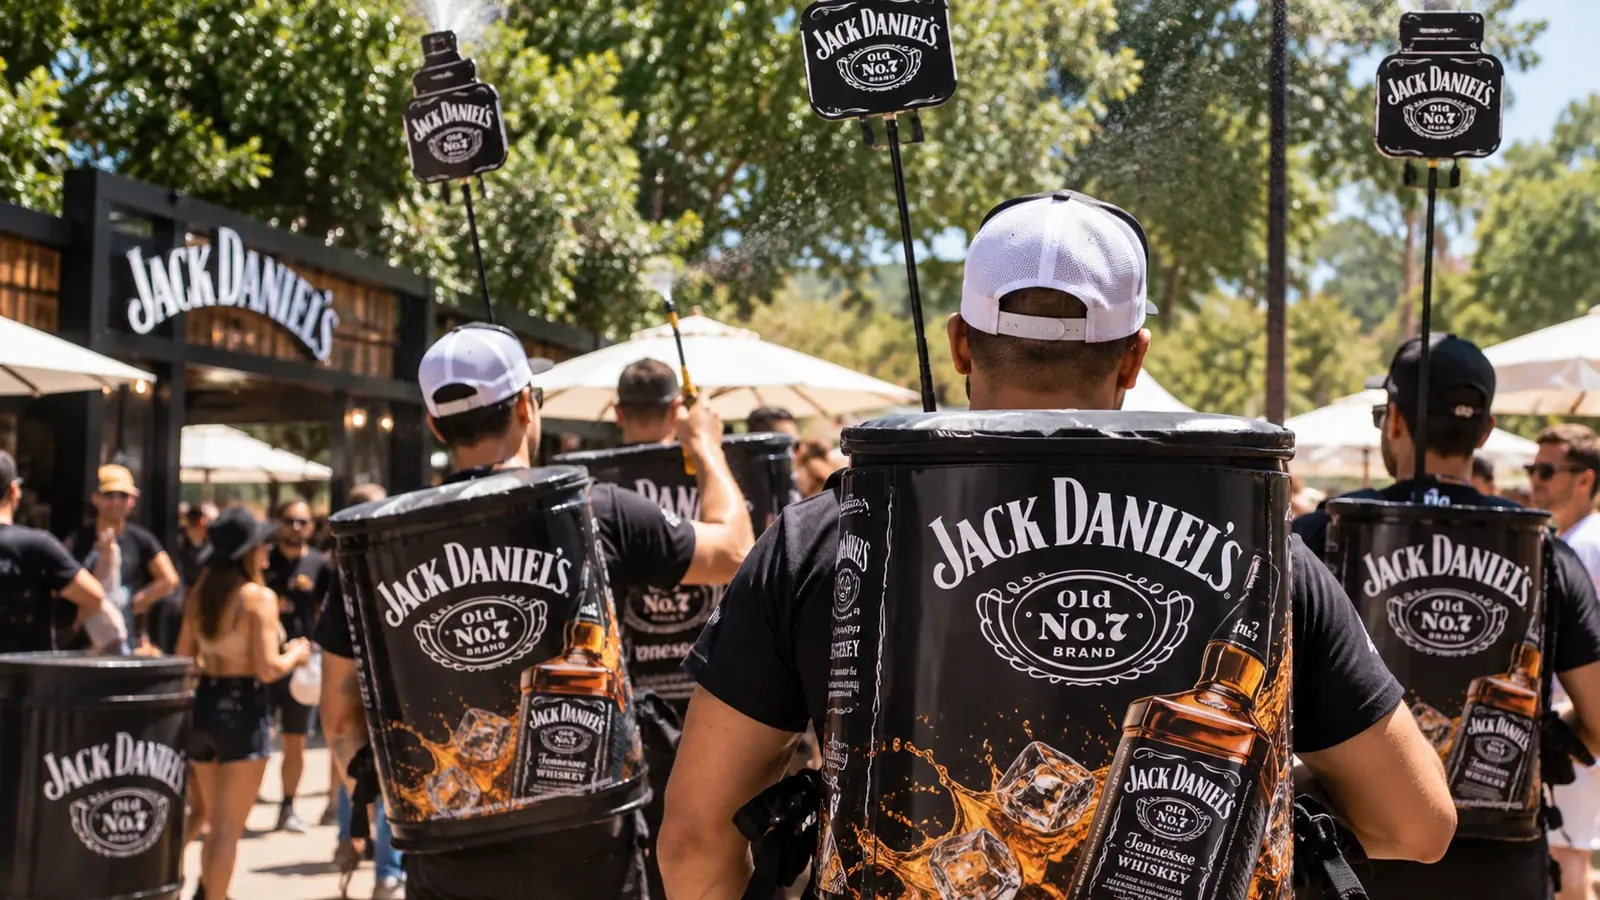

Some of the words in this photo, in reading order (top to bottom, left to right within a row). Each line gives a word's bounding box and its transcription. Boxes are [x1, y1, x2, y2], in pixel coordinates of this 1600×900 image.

[812, 16, 863, 60] JACK
[860, 8, 941, 48] DANIEL'S
[862, 60, 898, 76] No.7
[867, 51, 891, 62] Old
[1387, 72, 1428, 105] JACK
[1429, 65, 1495, 107] DANIEL'S
[1429, 104, 1450, 112] Old
[411, 109, 443, 142] JACK
[440, 101, 494, 129] DANIEL'S
[126, 244, 217, 335] JACK
[217, 226, 340, 361] DANIEL'S
[928, 496, 1050, 590] JACK
[1052, 476, 1243, 592] DANIEL'S
[1363, 544, 1430, 598] JACK
[1431, 533, 1533, 607] DANIEL'S
[377, 558, 451, 628] JACK
[443, 542, 572, 595] DANIEL'S
[1056, 589, 1112, 609] Old
[1431, 599, 1464, 613] Old
[461, 607, 497, 626] Old
[1038, 612, 1130, 642] No.7
[1420, 611, 1473, 633] No.7
[453, 619, 511, 648] No.7
[1428, 633, 1465, 642] BRAND
[466, 641, 506, 656] BRAND
[1053, 646, 1116, 658] BRAND
[529, 706, 559, 729] JACK
[560, 703, 605, 735] DANIEL'S
[1467, 716, 1495, 735] JACK
[43, 742, 112, 801] JACK
[536, 768, 586, 782] WHISKEY
[1124, 765, 1171, 793] JACK
[1170, 763, 1236, 820] DANIEL'S
[1155, 810, 1189, 828] No.7
[1165, 804, 1187, 817] Old
[1124, 831, 1196, 866] Tennessee
[1117, 854, 1191, 885] WHISKEY
